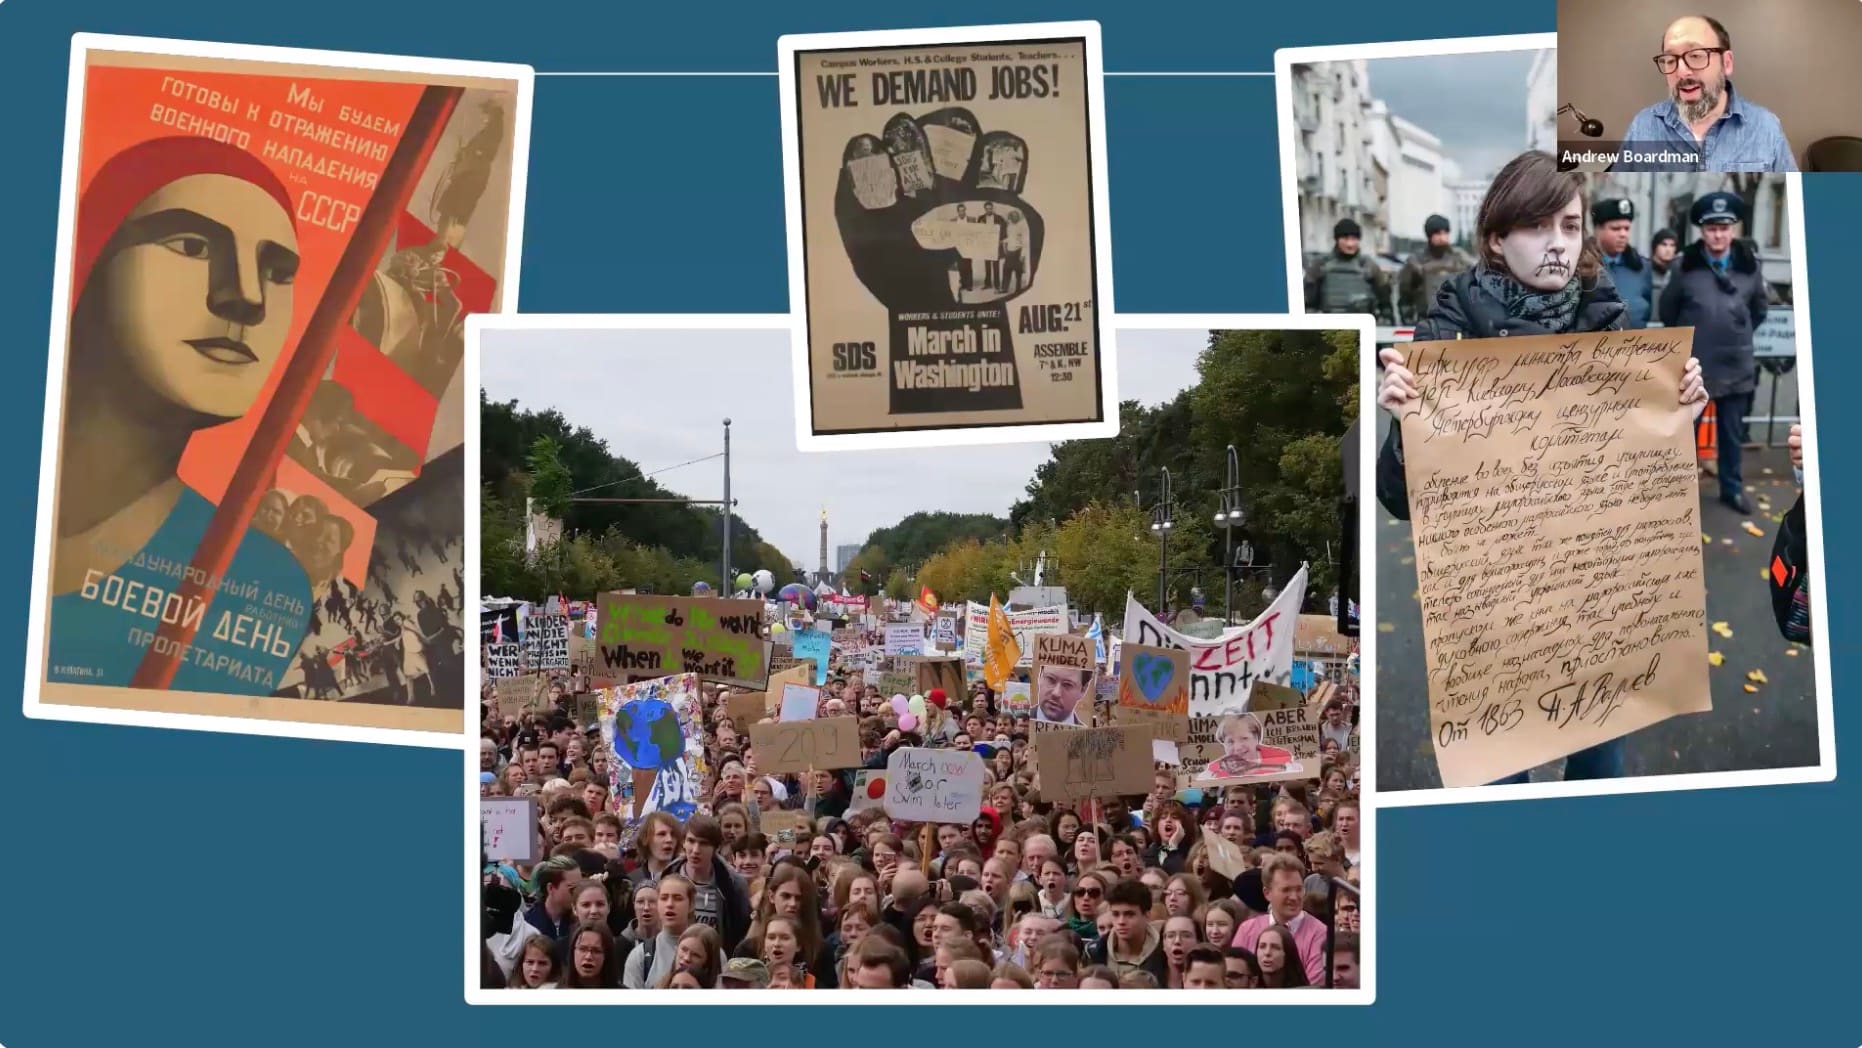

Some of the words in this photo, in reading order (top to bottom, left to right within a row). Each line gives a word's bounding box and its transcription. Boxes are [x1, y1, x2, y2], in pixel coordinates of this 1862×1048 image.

[287, 82, 325, 113] Мы
[816, 73, 858, 109] WE
[872, 67, 977, 106] DEMAND
[988, 63, 1059, 100] JOBS!
[161, 76, 239, 114] ГОТОВЫ
[247, 104, 261, 122] К
[268, 110, 388, 161] ОТРАЖЕНИЮ
[150, 103, 250, 150] ВОЕННОГО
[262, 139, 379, 191] НАПАДЕНИЯ
[297, 190, 361, 233] СССР
[1018, 304, 1069, 334] AUG.
[907, 324, 977, 356] March
[981, 323, 1001, 353] in
[1034, 341, 1088, 358] ASSEMBLE
[832, 341, 877, 372] SDS
[894, 357, 1014, 392] Washington
[80, 568, 206, 632] БОЕВОЙ
[213, 610, 291, 658] ДЕНЬ
[525, 615, 567, 628] KINDER
[665, 608, 683, 627] do
[720, 612, 763, 639] want
[525, 639, 568, 650] MACHT
[544, 628, 565, 639] DIE
[1191, 612, 1280, 670] ZEIT
[127, 628, 274, 689] ПРОЛЕТАРИАТА
[489, 645, 518, 657] WER
[489, 658, 519, 667] WENN
[600, 645, 660, 669] When
[489, 668, 519, 677] NICHT
[1264, 709, 1306, 727] ABER
[900, 752, 936, 770] March
[924, 778, 948, 790] or
